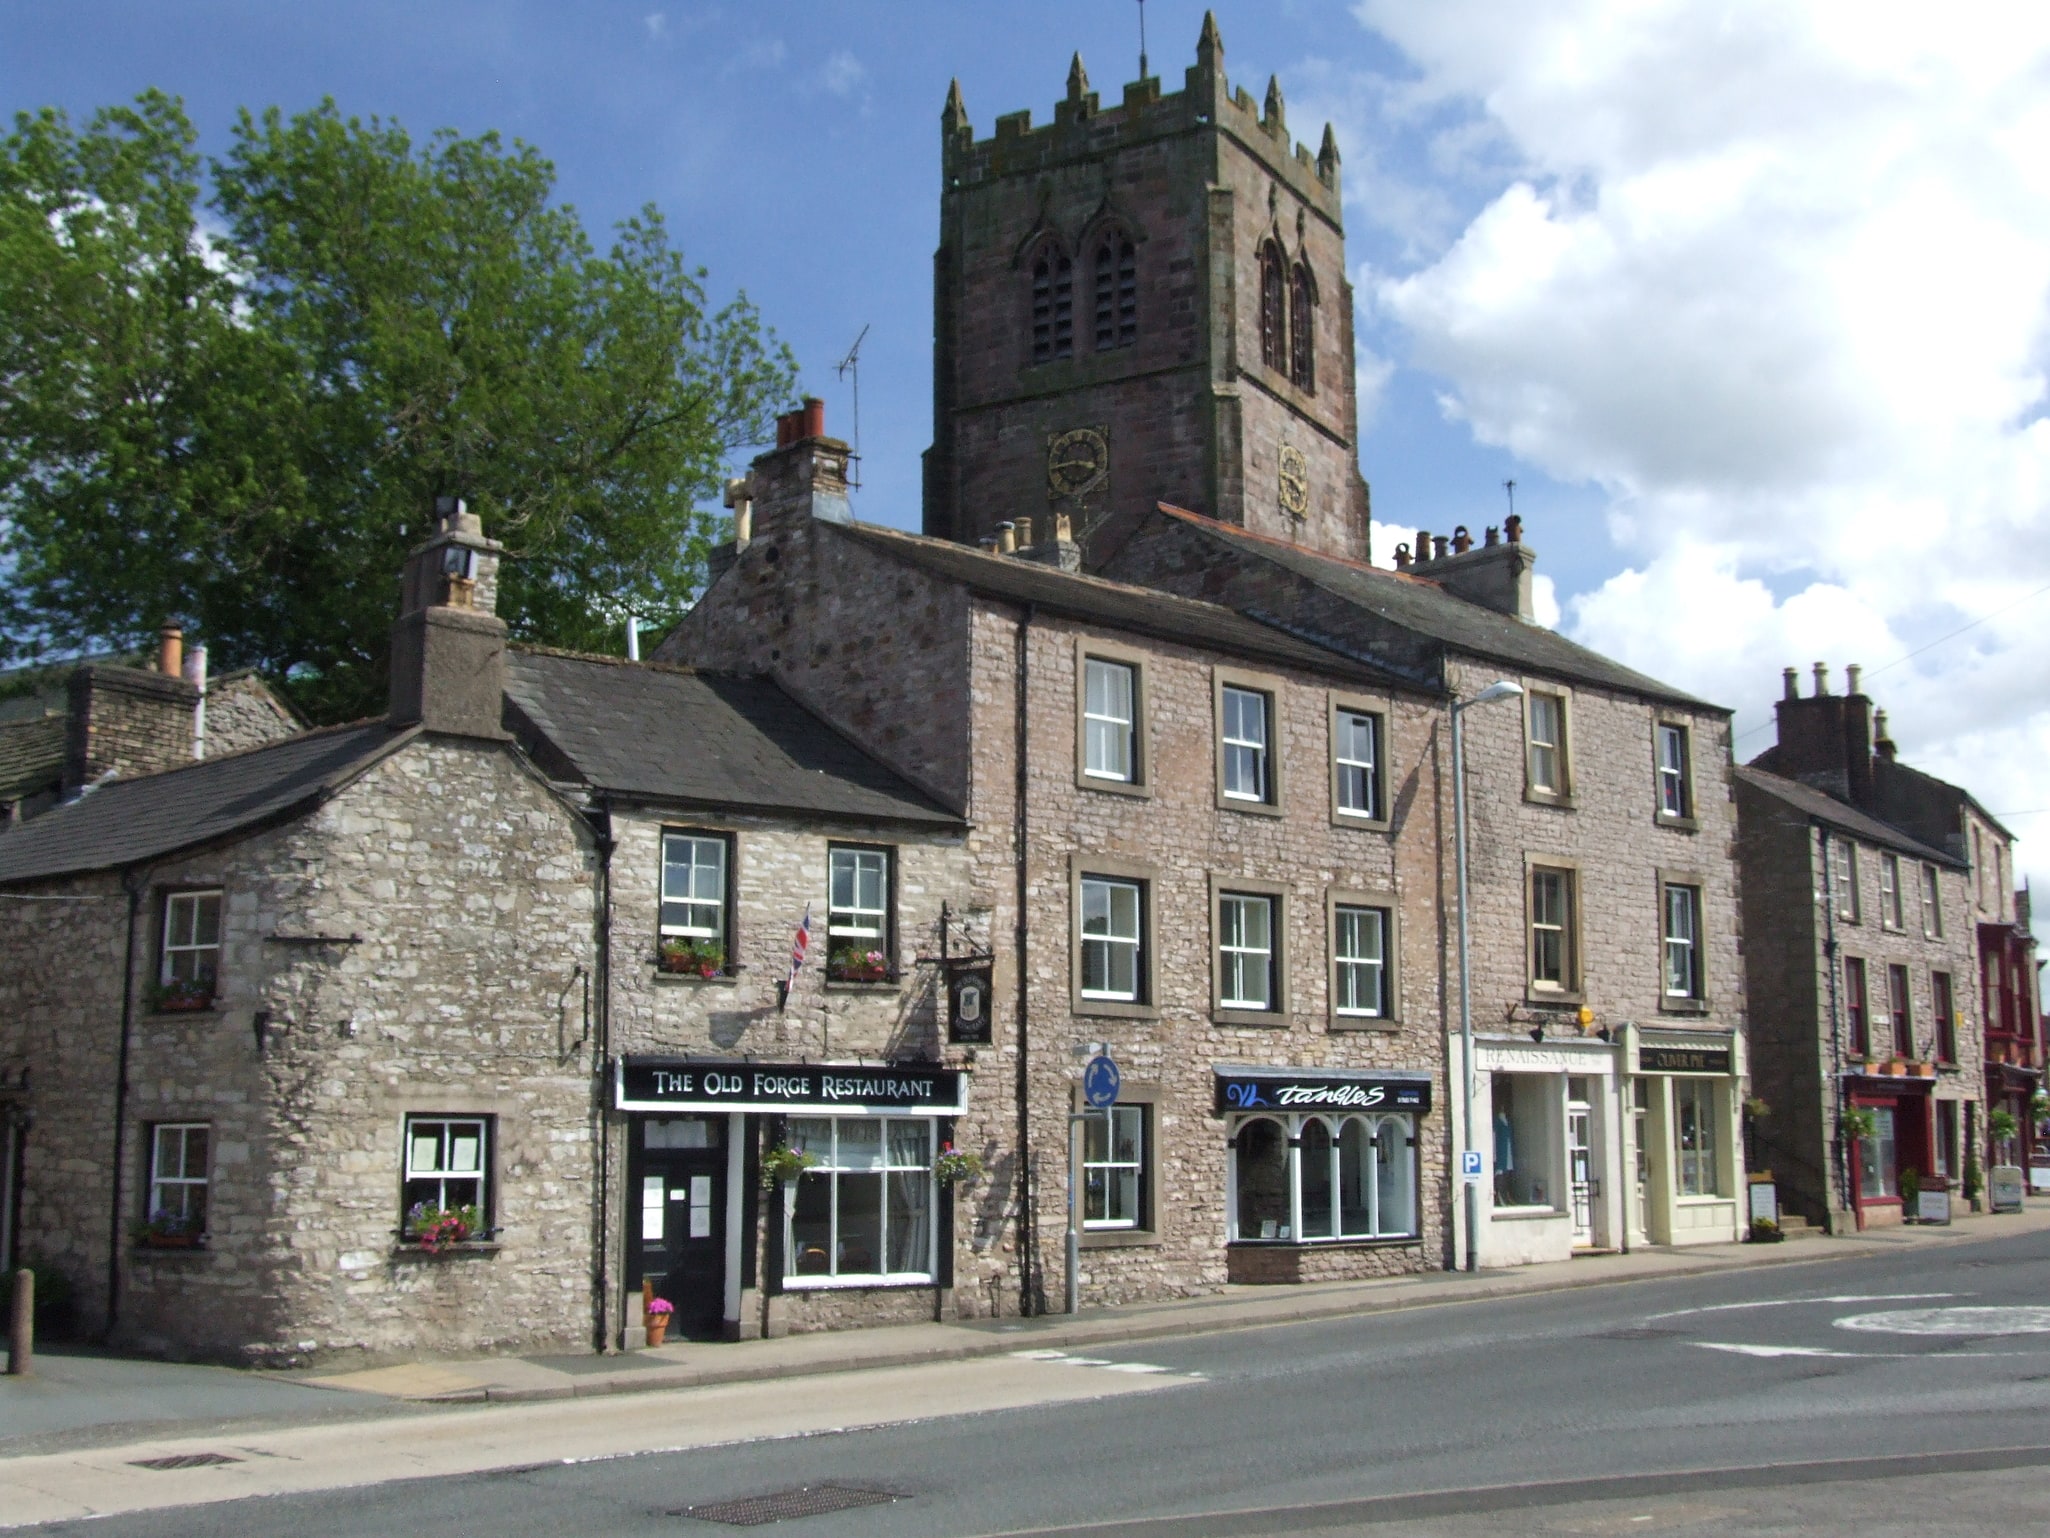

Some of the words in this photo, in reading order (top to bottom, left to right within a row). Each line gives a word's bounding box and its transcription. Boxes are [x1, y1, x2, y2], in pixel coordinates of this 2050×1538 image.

[1485, 1048, 1586, 1067] RENAISSANCE
[653, 1071, 693, 1094] THE
[704, 1072, 743, 1095] OLD
[754, 1073, 810, 1098] FORGE
[822, 1076, 934, 1100] RESTAURANT
[1465, 1154, 1478, 1172] P
